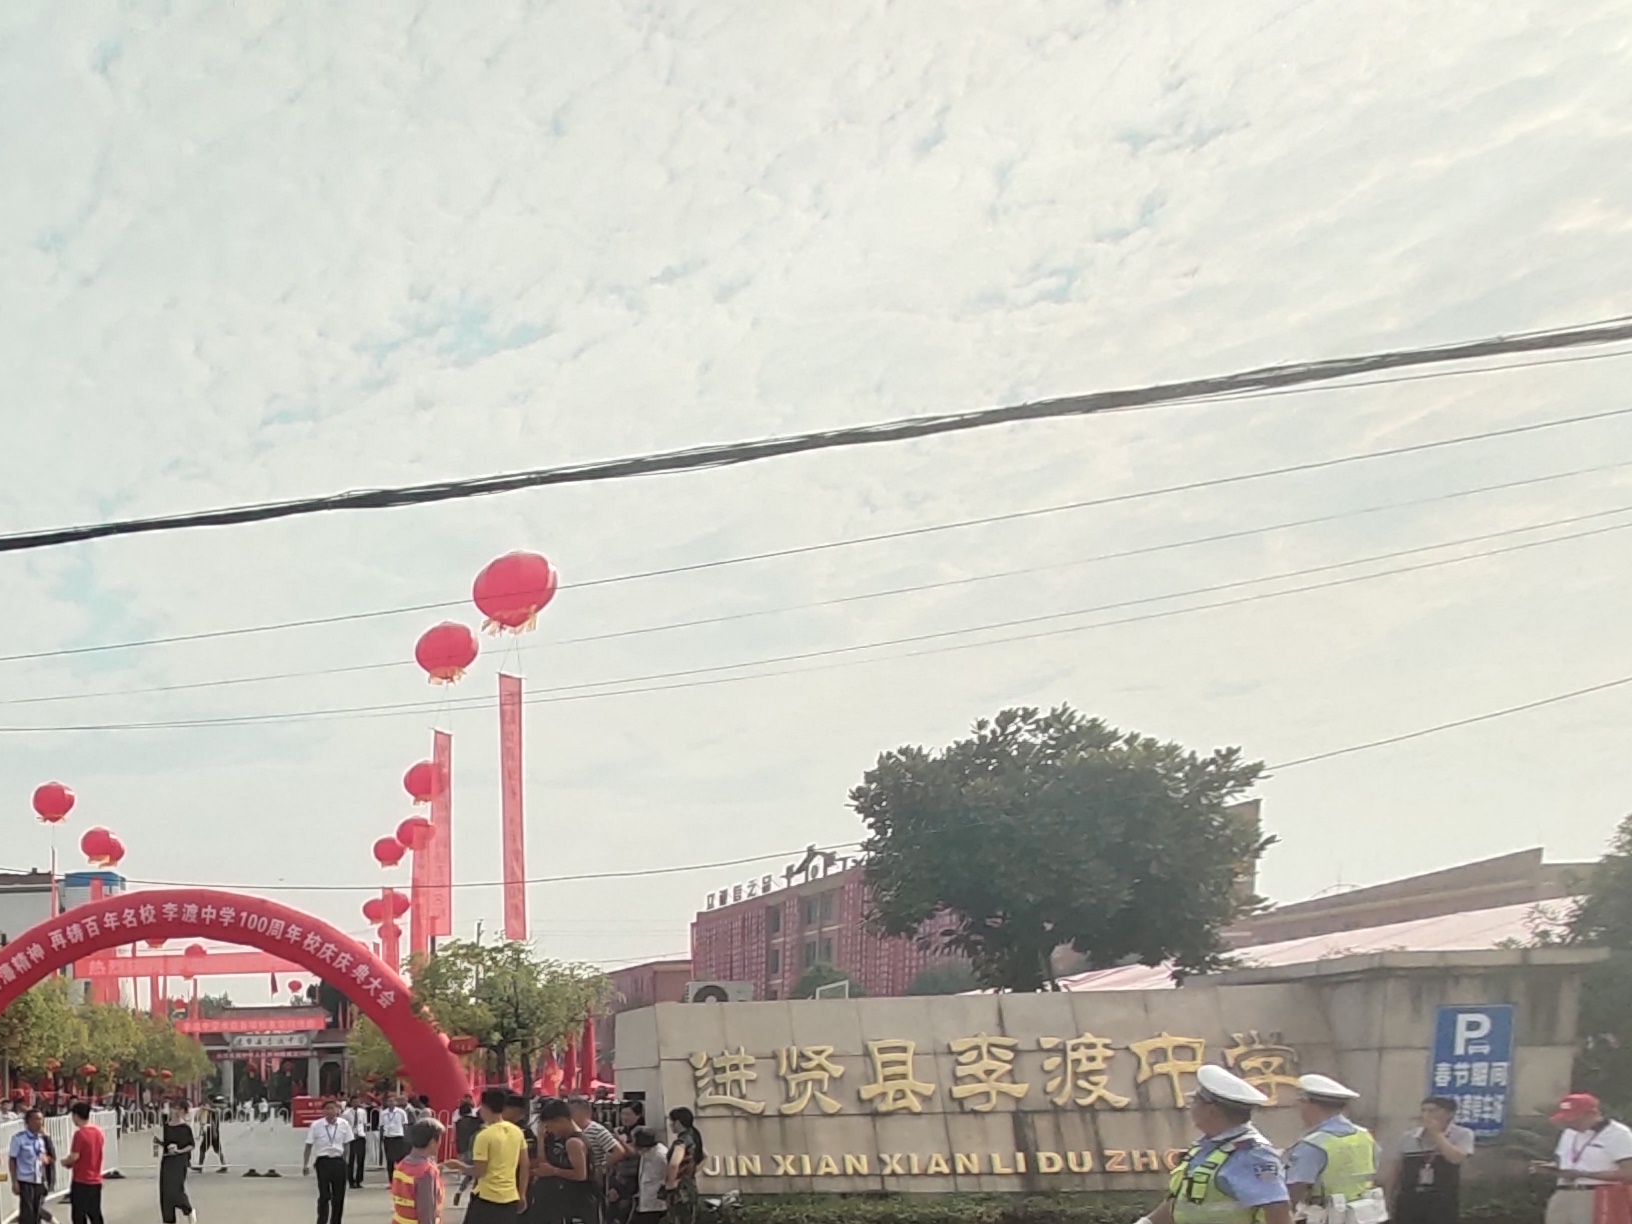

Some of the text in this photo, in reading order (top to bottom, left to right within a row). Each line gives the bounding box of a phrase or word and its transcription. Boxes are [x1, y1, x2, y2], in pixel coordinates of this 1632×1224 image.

[48, 904, 156, 951] 再铸百年名校
[162, 902, 395, 1009] 李渡中学100周年校庆庆典大会
[1453, 1012, 1491, 1056] P
[689, 1029, 1299, 1115] 进贤县李渡中学
[1434, 1061, 1509, 1088] 春节期间
[702, 1155, 761, 1177] JIN
[771, 1154, 868, 1176] XIAN
[879, 1152, 979, 1176] XIAN
[990, 1152, 1028, 1175] LI
[1037, 1151, 1094, 1174] DU
